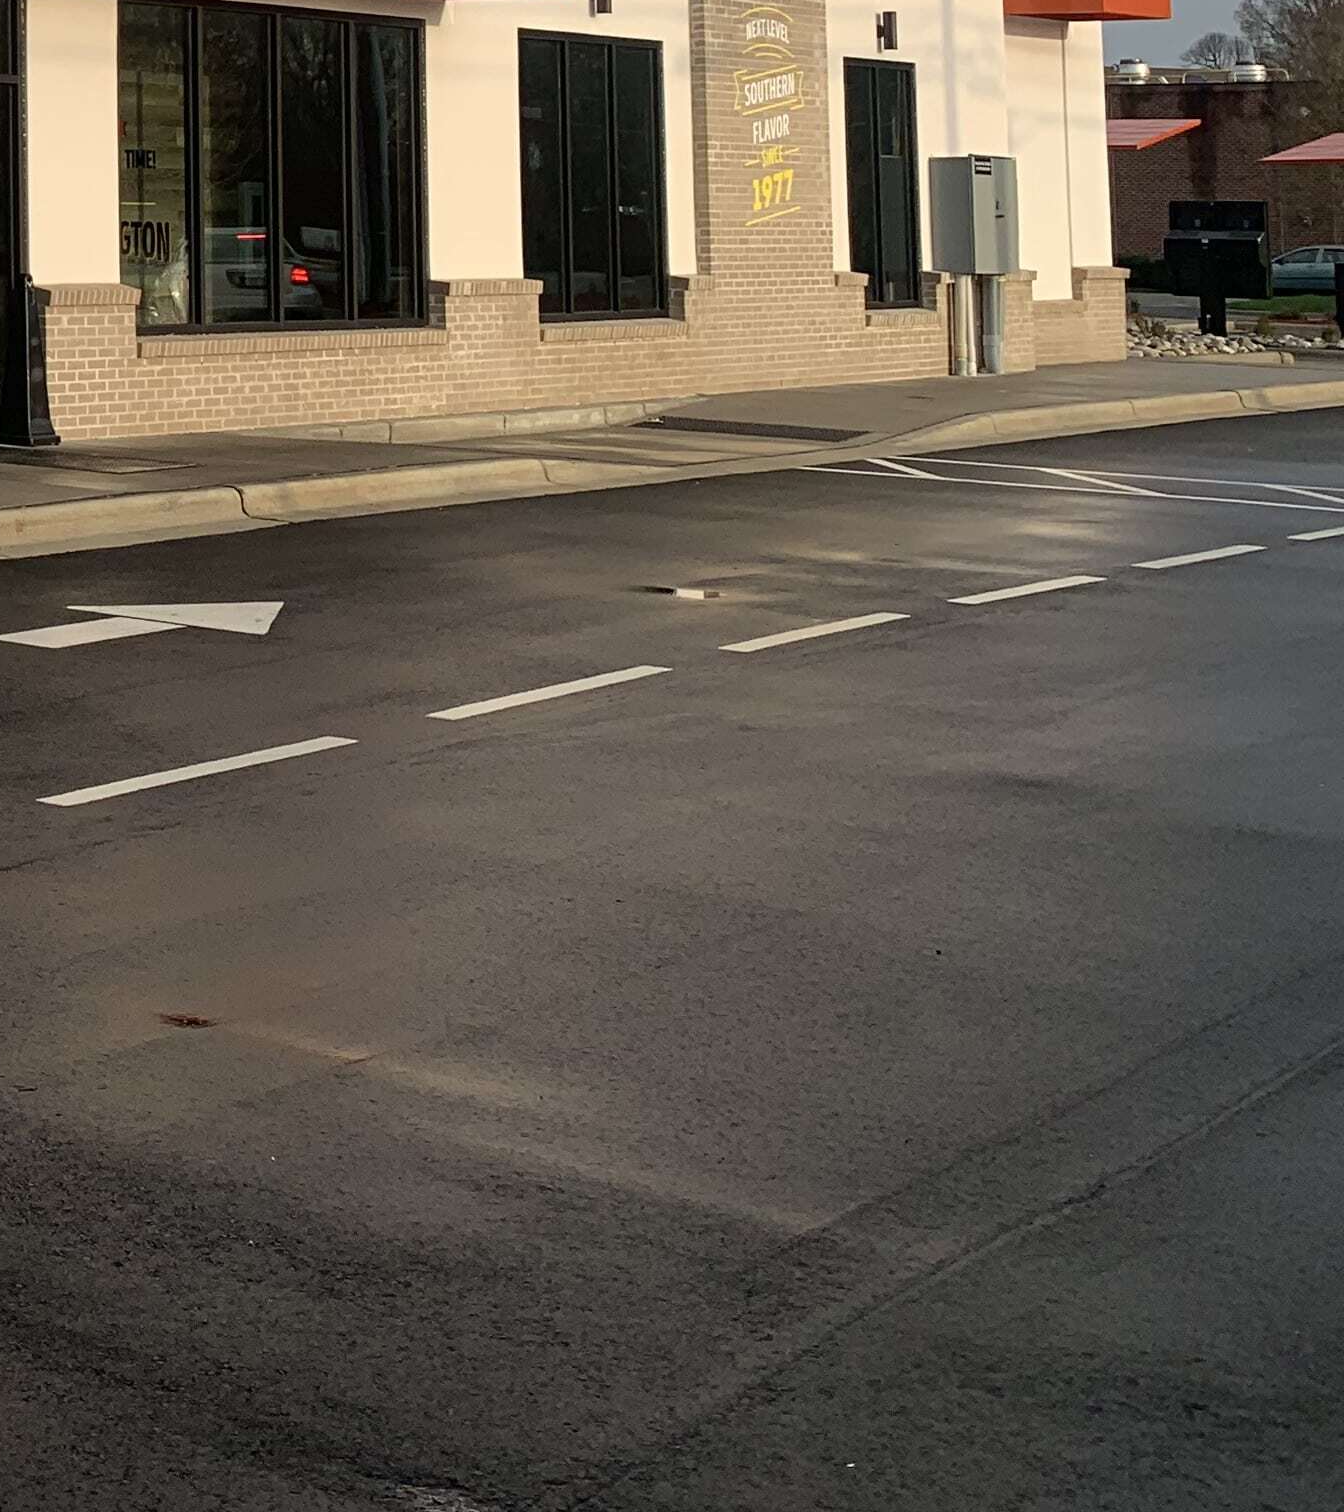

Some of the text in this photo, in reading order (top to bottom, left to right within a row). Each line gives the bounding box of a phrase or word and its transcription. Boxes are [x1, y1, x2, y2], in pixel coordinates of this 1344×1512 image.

[746, 19, 790, 44] NEXT LEVEL
[744, 73, 795, 106] SOUTHERN
[752, 115, 789, 145] FLAVOR
[124, 148, 157, 169] TIME!
[752, 169, 794, 211] 1977
